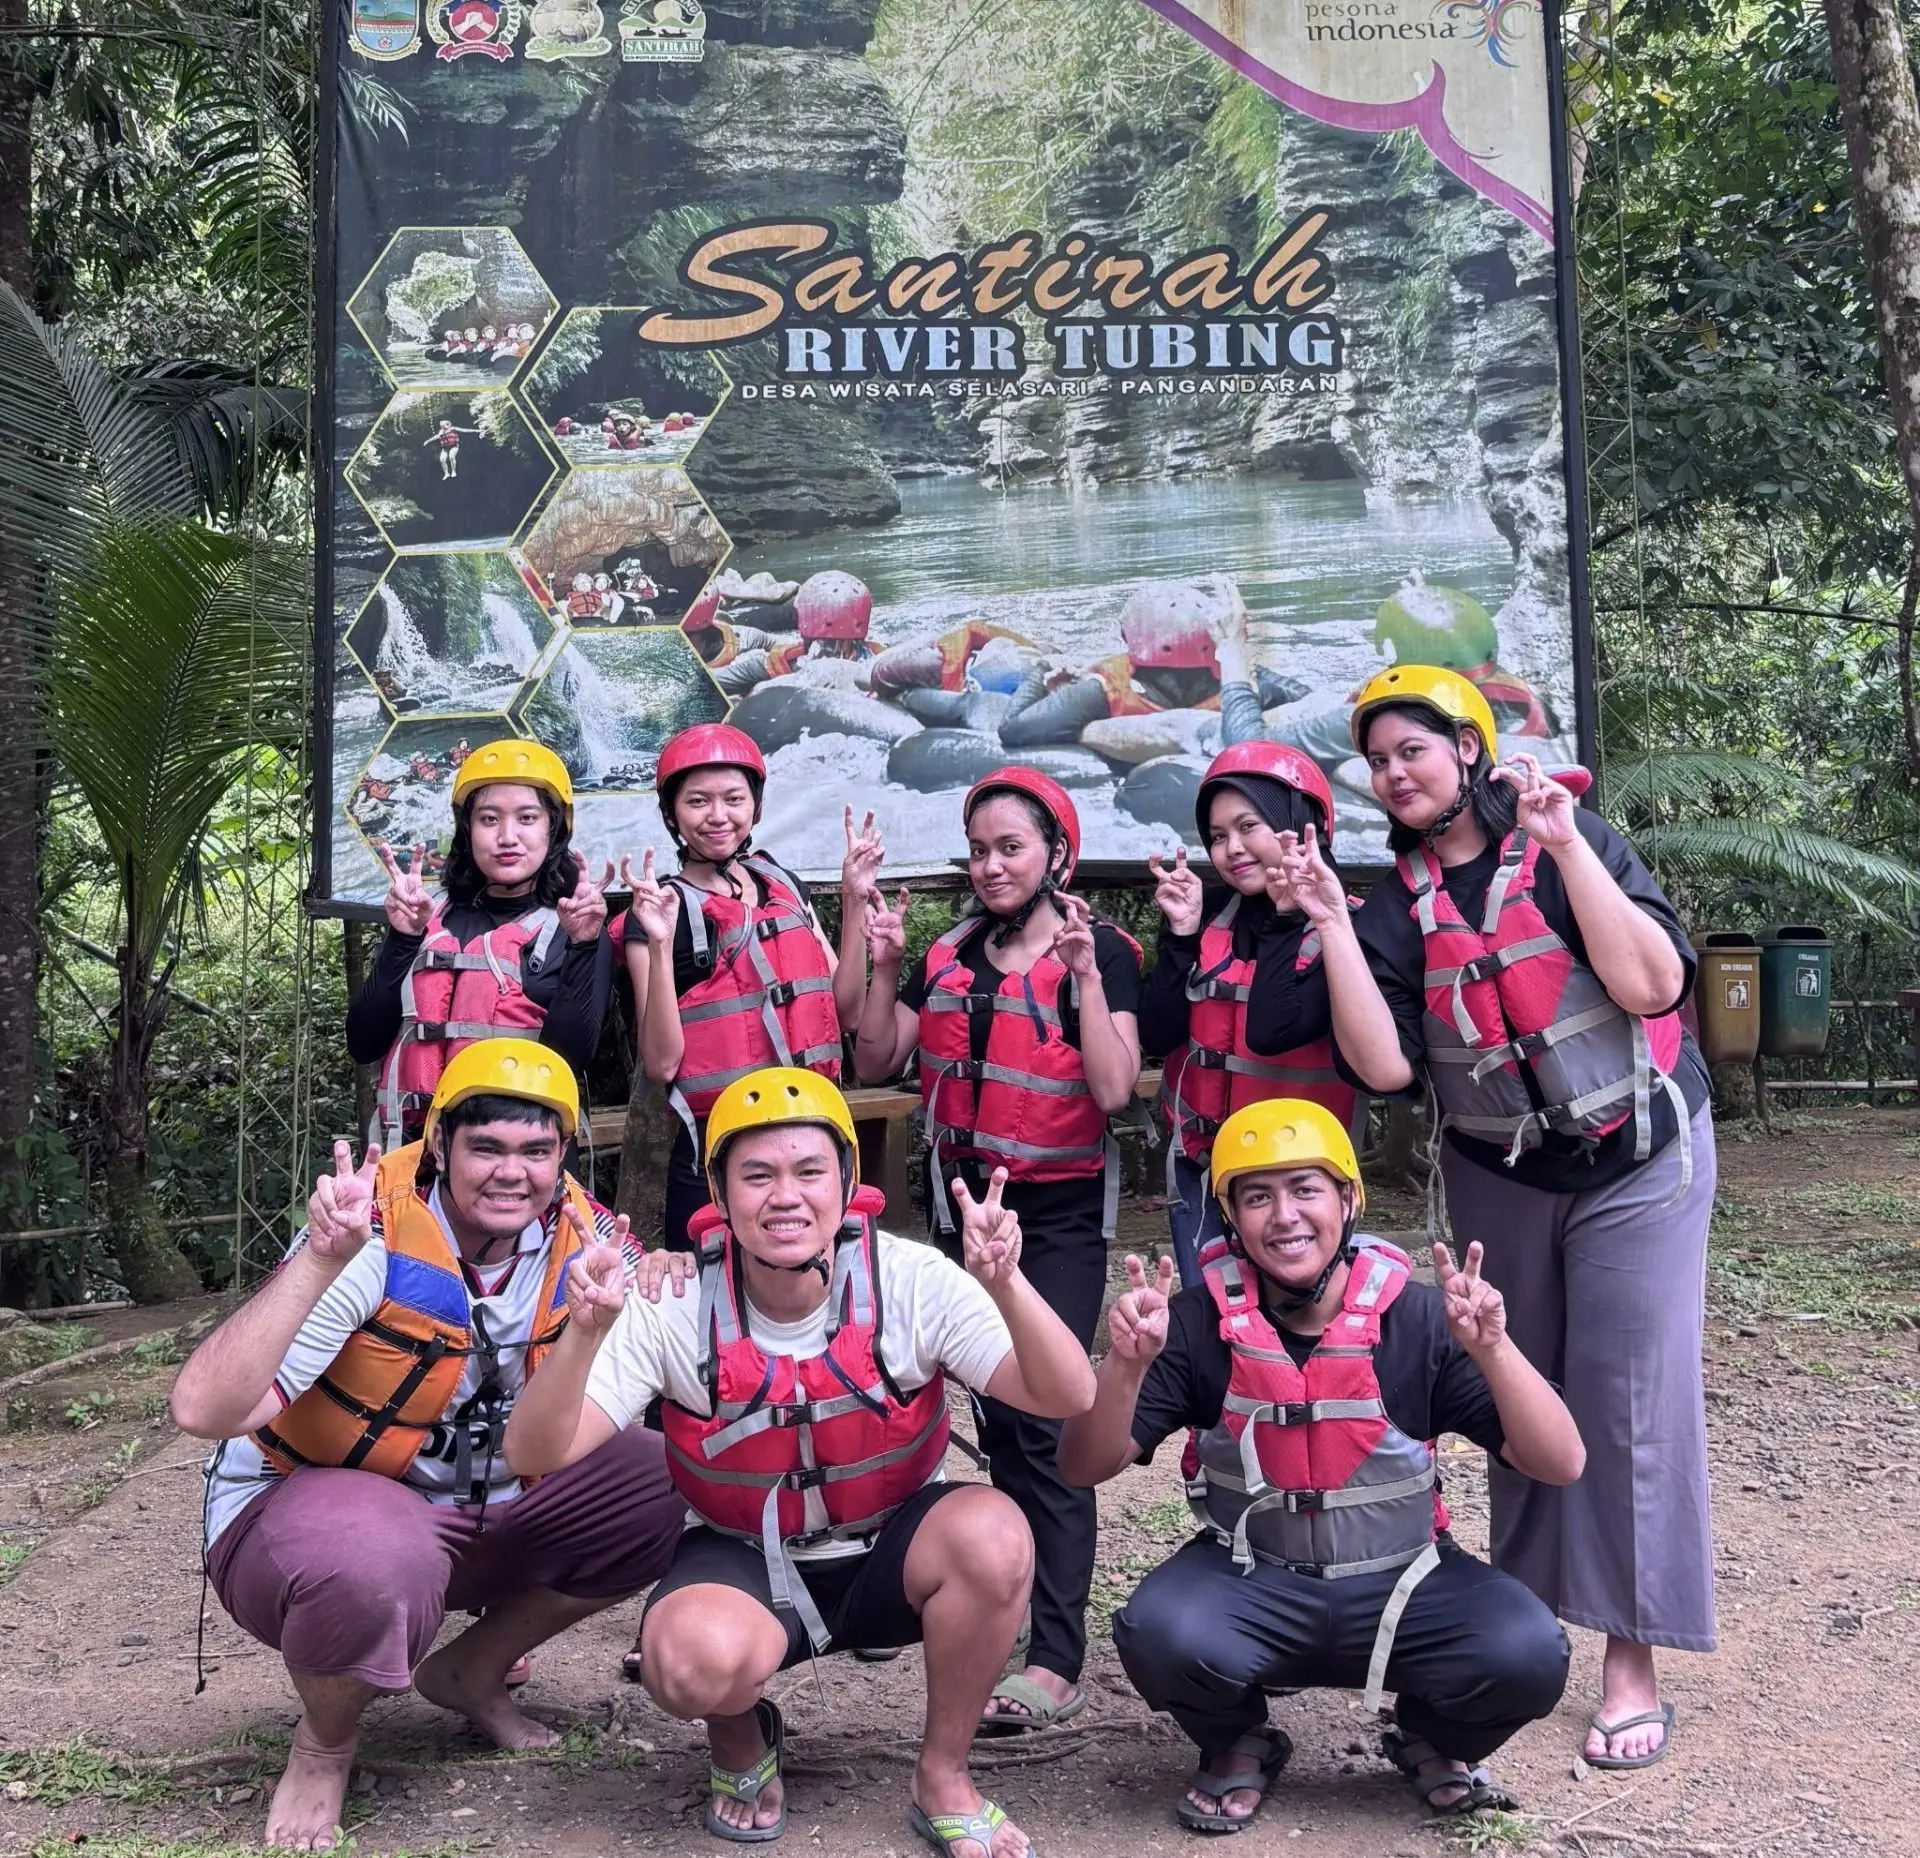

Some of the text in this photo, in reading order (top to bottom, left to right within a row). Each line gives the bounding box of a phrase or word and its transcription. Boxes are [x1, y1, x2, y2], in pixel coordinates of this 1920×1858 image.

[1306, 0, 1398, 21] pesona
[1306, 18, 1458, 41] indonesia
[624, 40, 700, 53] SANTIRAH
[638, 212, 1329, 343] Santirah
[785, 321, 1335, 372] RIVER TUBING
[742, 384, 816, 398] DESA
[829, 382, 934, 397] WISATA
[948, 380, 1087, 397] SELASARI
[1121, 377, 1337, 394] PANGANDARAN
